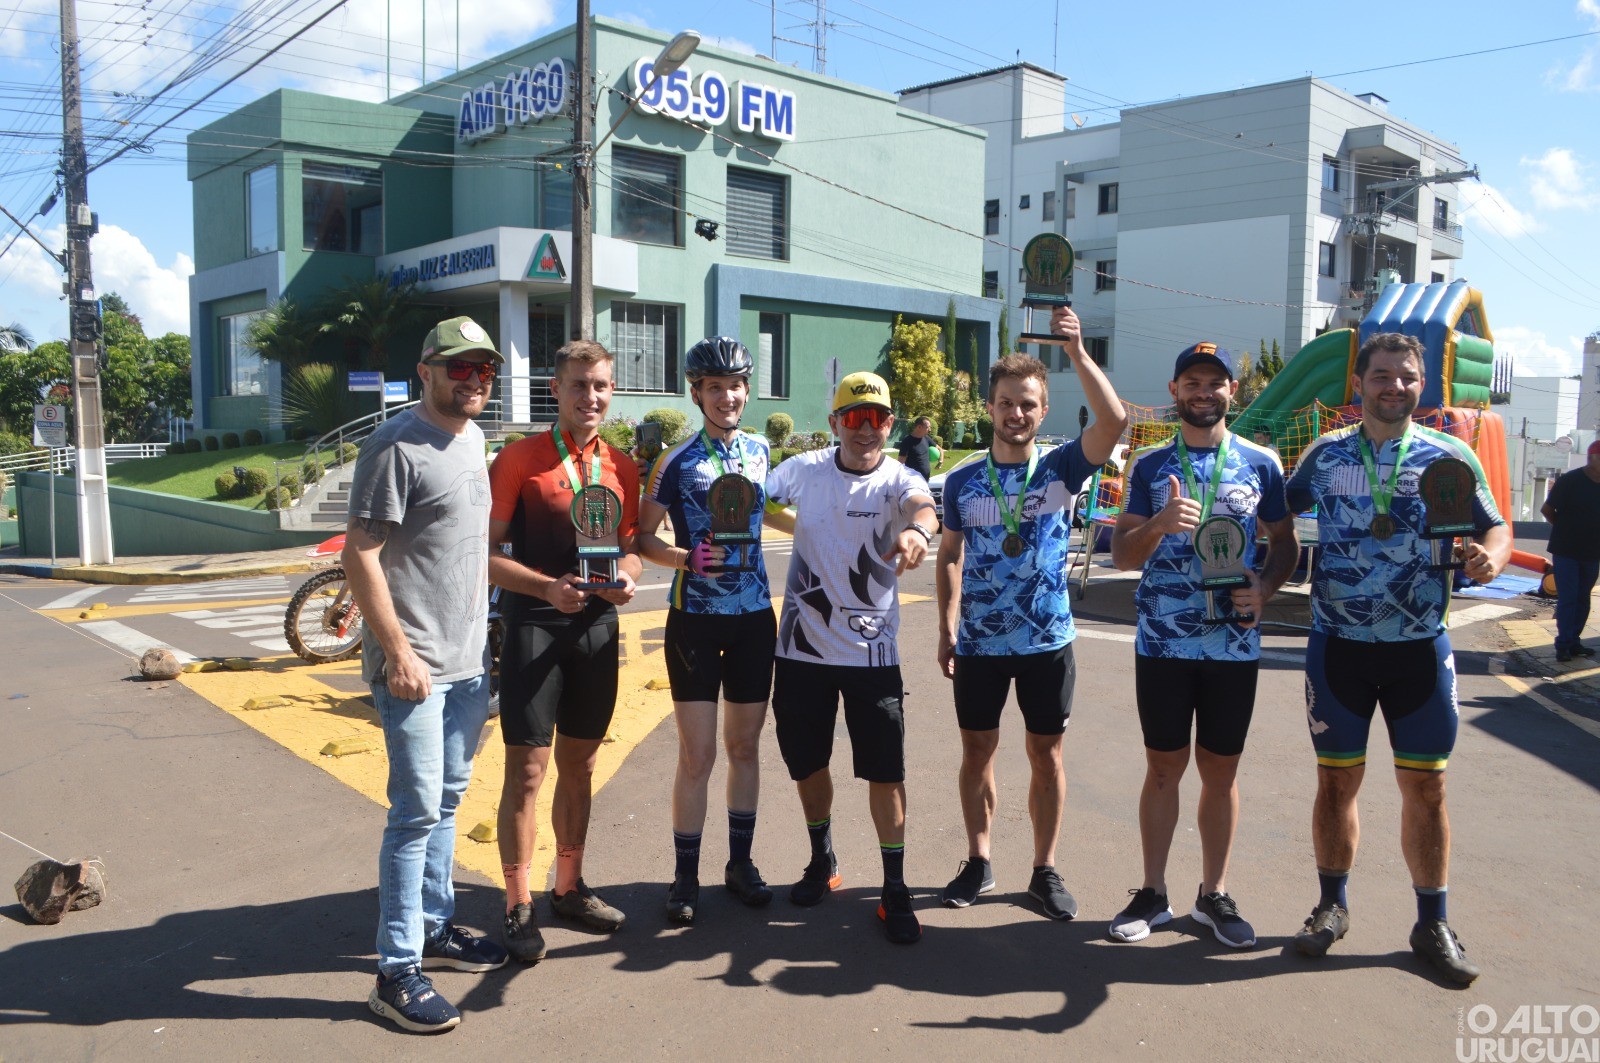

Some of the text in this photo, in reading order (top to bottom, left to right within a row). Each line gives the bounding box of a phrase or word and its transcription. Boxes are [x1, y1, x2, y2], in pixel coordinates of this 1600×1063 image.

[457, 58, 565, 141] AM 1160
[636, 59, 795, 137] 95.9 FM
[419, 257, 439, 281] LUZ
[439, 254, 448, 278] E
[448, 244, 495, 276] ALEGRIA
[46, 409, 53, 418] E
[370, 998, 385, 1014] FILA
[419, 989, 436, 1003] FILA
